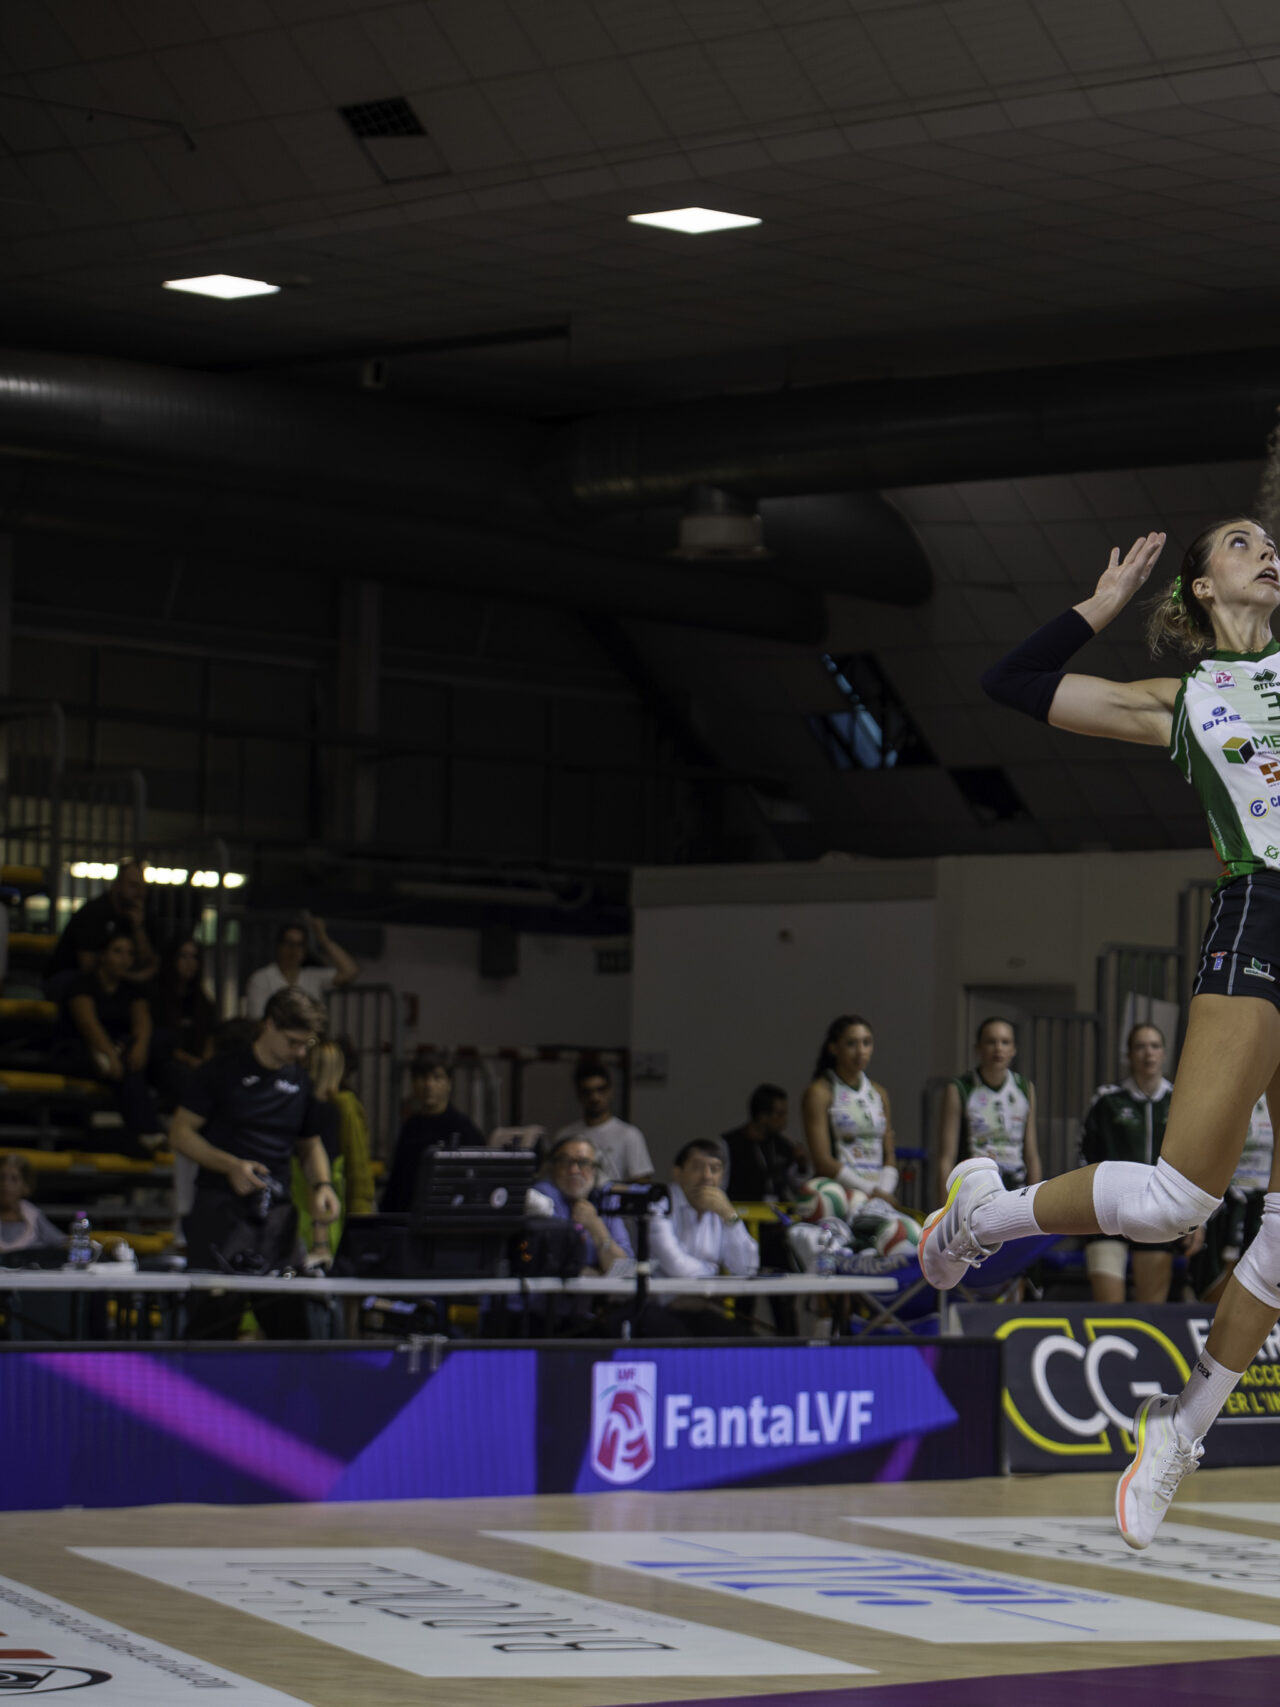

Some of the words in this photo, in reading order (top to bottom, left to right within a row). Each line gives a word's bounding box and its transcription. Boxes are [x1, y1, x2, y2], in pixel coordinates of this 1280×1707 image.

[1202, 715, 1241, 731] BHS
[616, 1367, 637, 1381] LVF
[664, 1390, 874, 1448] FantaLVF
